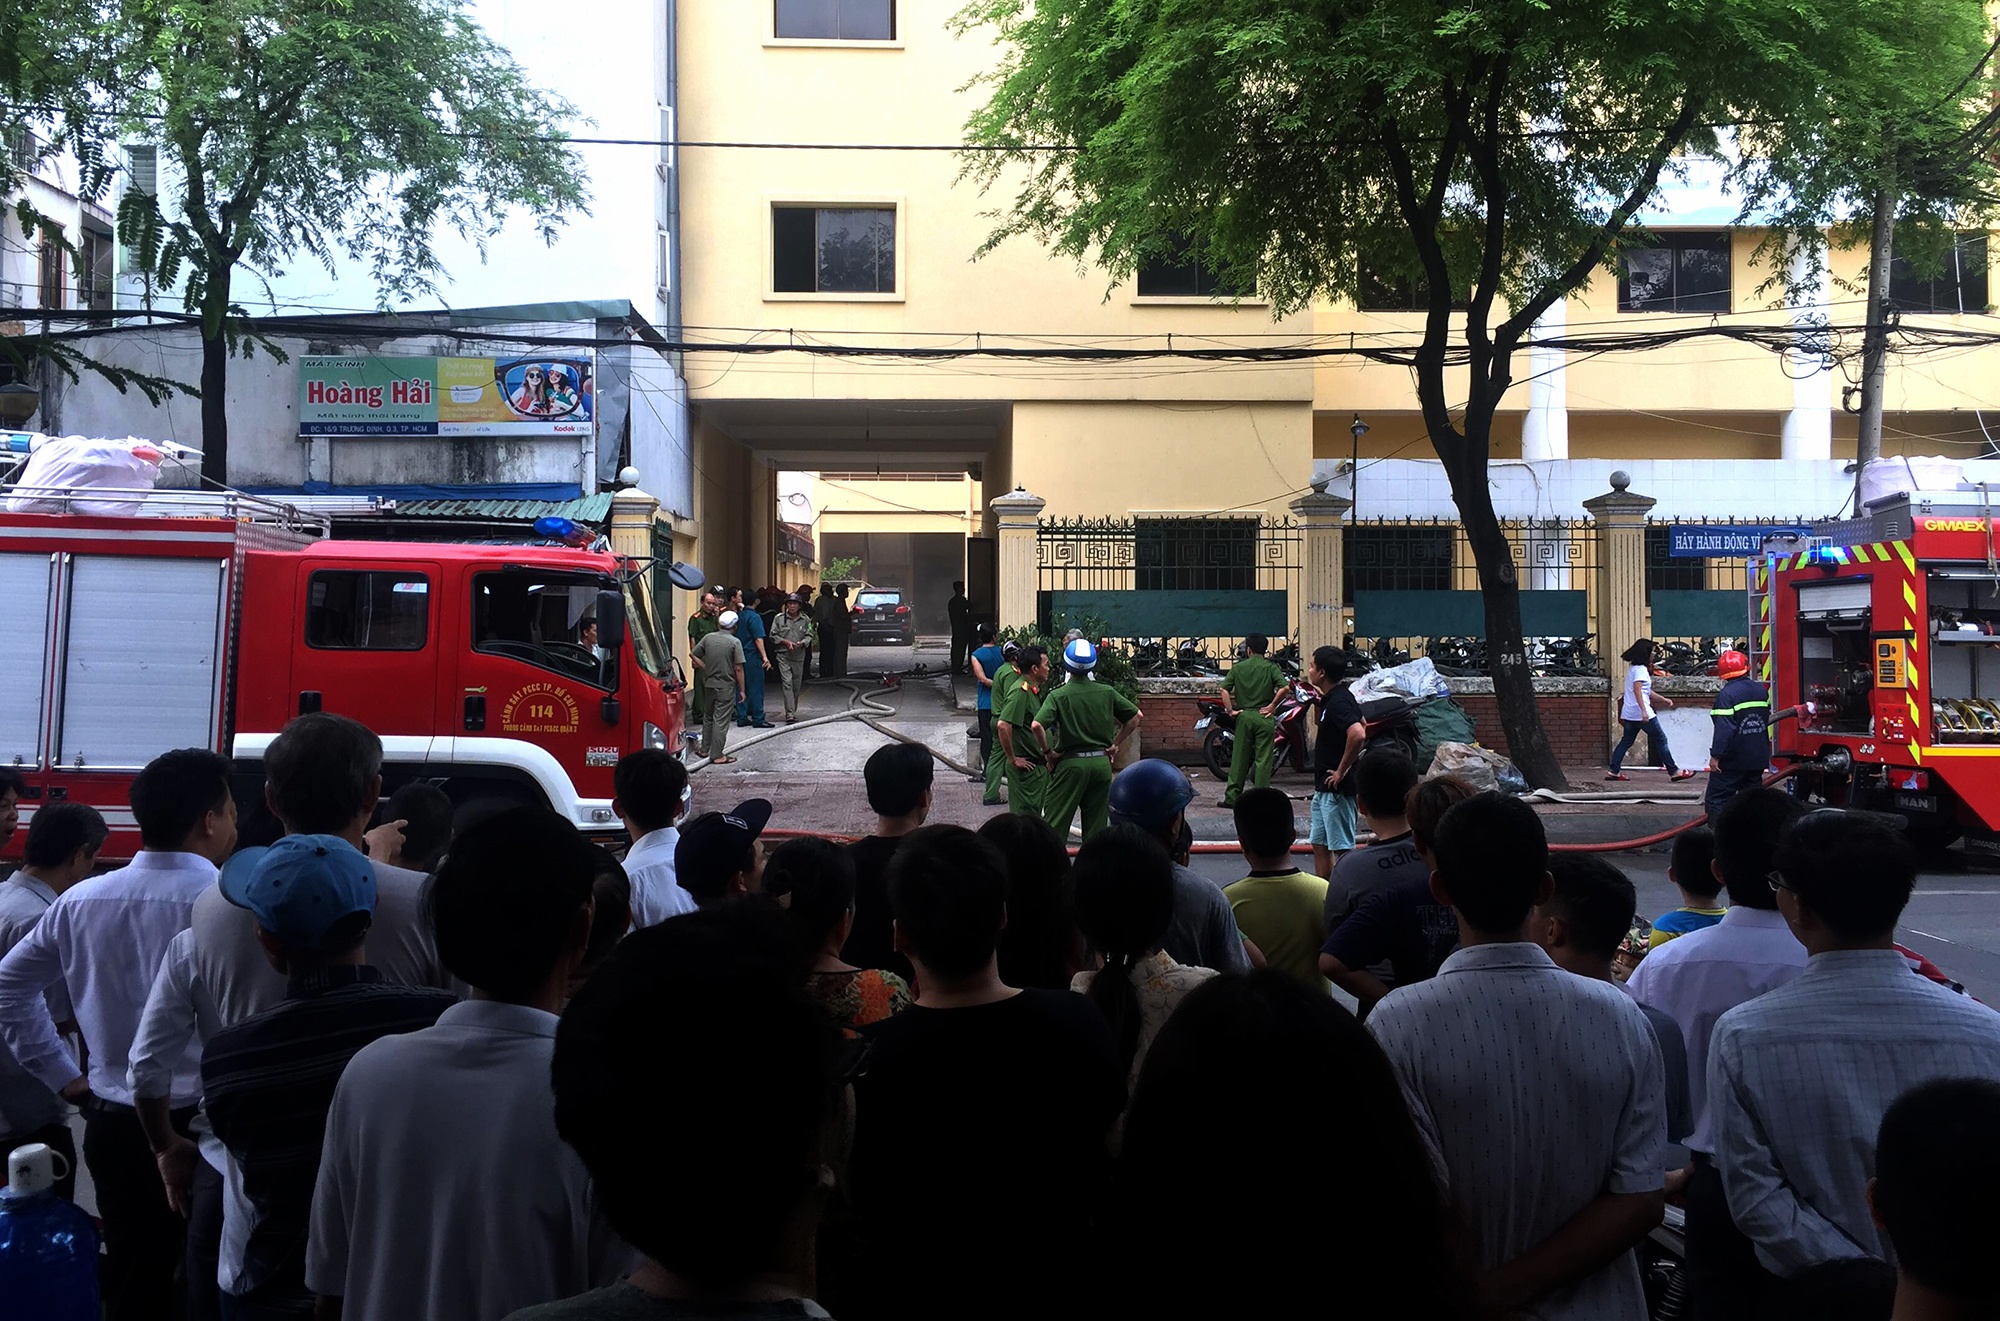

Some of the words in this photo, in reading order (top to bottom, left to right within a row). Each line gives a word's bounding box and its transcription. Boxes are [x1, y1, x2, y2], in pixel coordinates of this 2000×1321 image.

[307, 380, 384, 408] Hoàng
[392, 378, 431, 404] Hải
[391, 412, 420, 420] trang
[412, 425, 428, 433] HCM
[553, 424, 575, 432] Kodak
[1924, 519, 1987, 532] GIMAEX
[1696, 532, 1722, 550] HÀNH
[1724, 532, 1749, 553] ĐỘNG
[1500, 653, 1522, 665] 245
[522, 682, 541, 695] PCCC
[529, 704, 554, 718] 114
[1900, 796, 1929, 809] MAN
